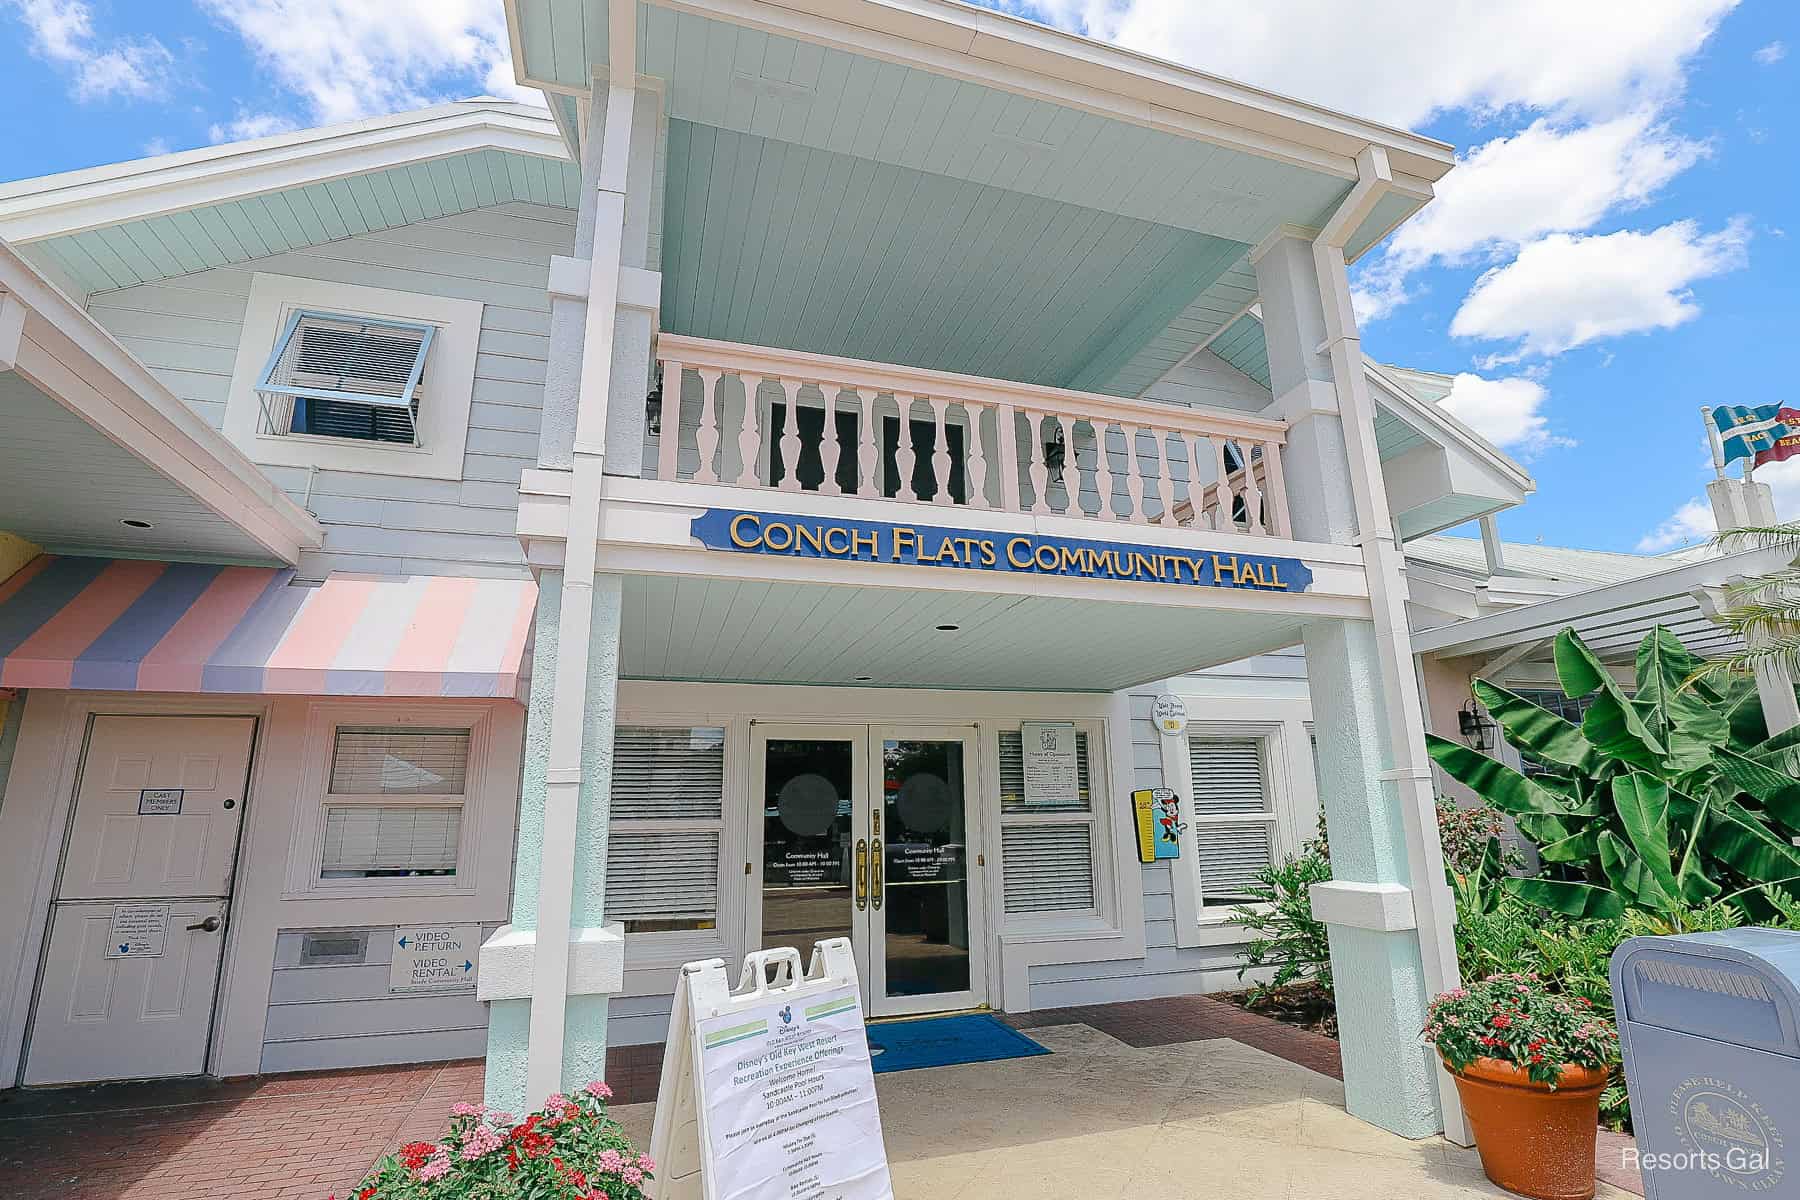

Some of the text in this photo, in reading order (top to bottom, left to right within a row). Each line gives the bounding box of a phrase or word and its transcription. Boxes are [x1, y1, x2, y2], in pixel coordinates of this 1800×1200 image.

[730, 514, 1288, 588] CONCH FLATS COMMUNITY HALL
[785, 851, 829, 860] Community Hall
[414, 942, 462, 952] RETURN
[415, 932, 450, 941] VIDEO
[412, 968, 457, 978] RENTAL
[413, 958, 448, 968] VIDEO
[737, 1054, 768, 1072] Disney's
[770, 1049, 783, 1062] Old
[784, 1046, 797, 1058] Key
[798, 1040, 815, 1054] West
[816, 1034, 838, 1047] Resort
[733, 1045, 844, 1086] Recreation Experience Offerings
[768, 1065, 816, 1087] Welcome Home!
[762, 1073, 825, 1099] Sandcastle Pool Hours
[766, 1094, 793, 1110] 10:00AM
[799, 1084, 824, 1100] 11:00PM
